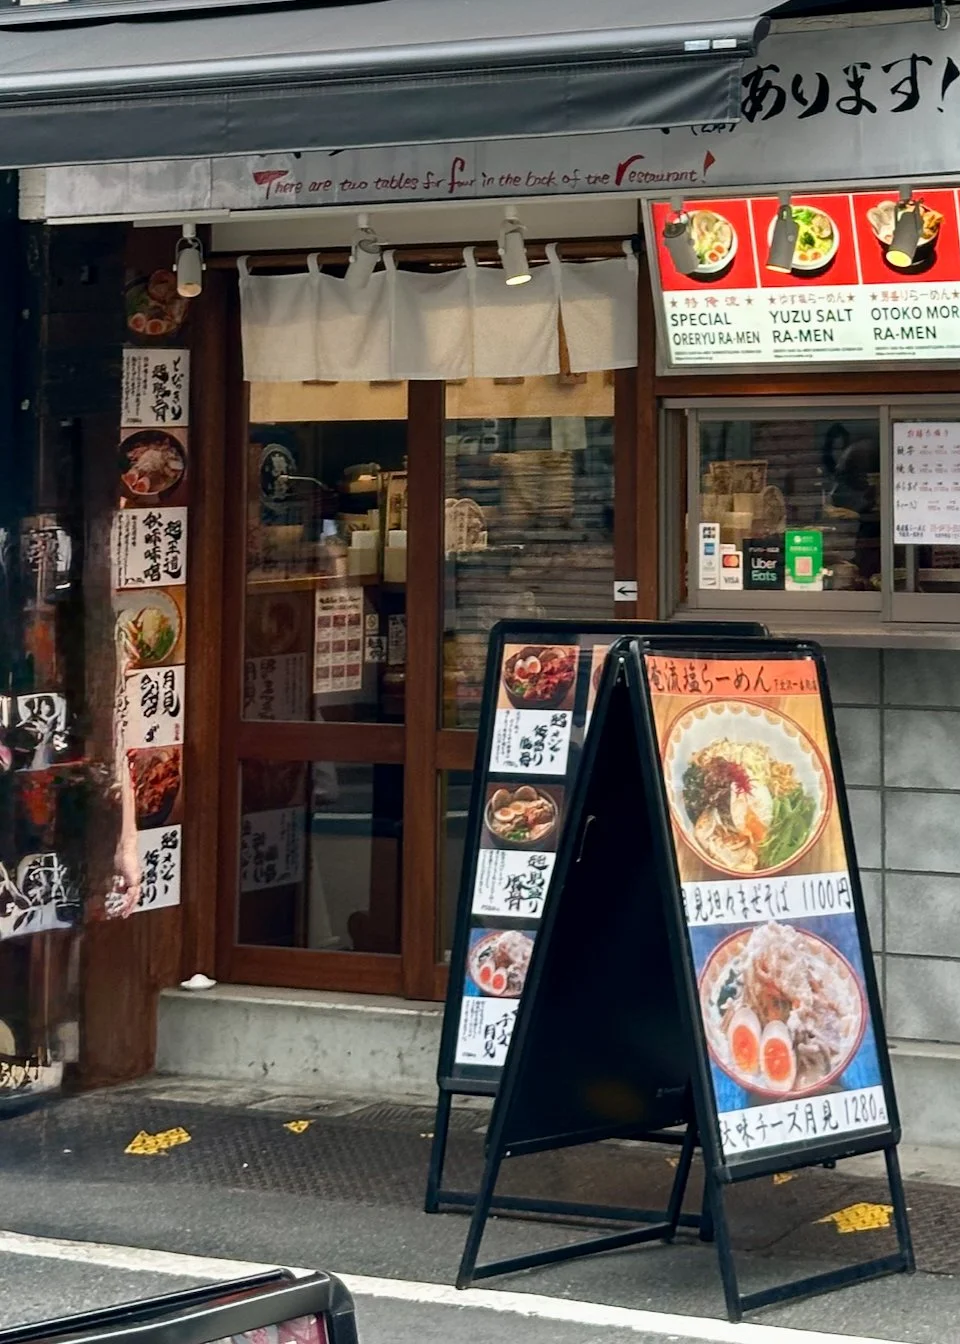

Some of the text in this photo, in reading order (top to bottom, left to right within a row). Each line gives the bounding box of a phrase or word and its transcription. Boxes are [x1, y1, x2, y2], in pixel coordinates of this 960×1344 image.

[252, 169, 301, 199] There
[308, 179, 331, 192] are
[340, 177, 368, 191] two
[375, 171, 419, 191] tables
[481, 172, 495, 187] in
[499, 172, 521, 187] the
[525, 171, 555, 187] back
[562, 169, 581, 188] of
[585, 173, 610, 185] the
[671, 311, 732, 326] SPECIAL
[769, 308, 853, 324] YUZU SALT
[870, 306, 922, 321] OTOKO
[673, 331, 761, 346] ORERYU RA-MEN
[772, 328, 834, 343] RA-MEN
[873, 326, 937, 341] RA-MEN
[751, 557, 778, 569] Uber
[724, 576, 739, 584] VISA
[751, 570, 777, 582] Eats
[802, 876, 852, 910] 1100円
